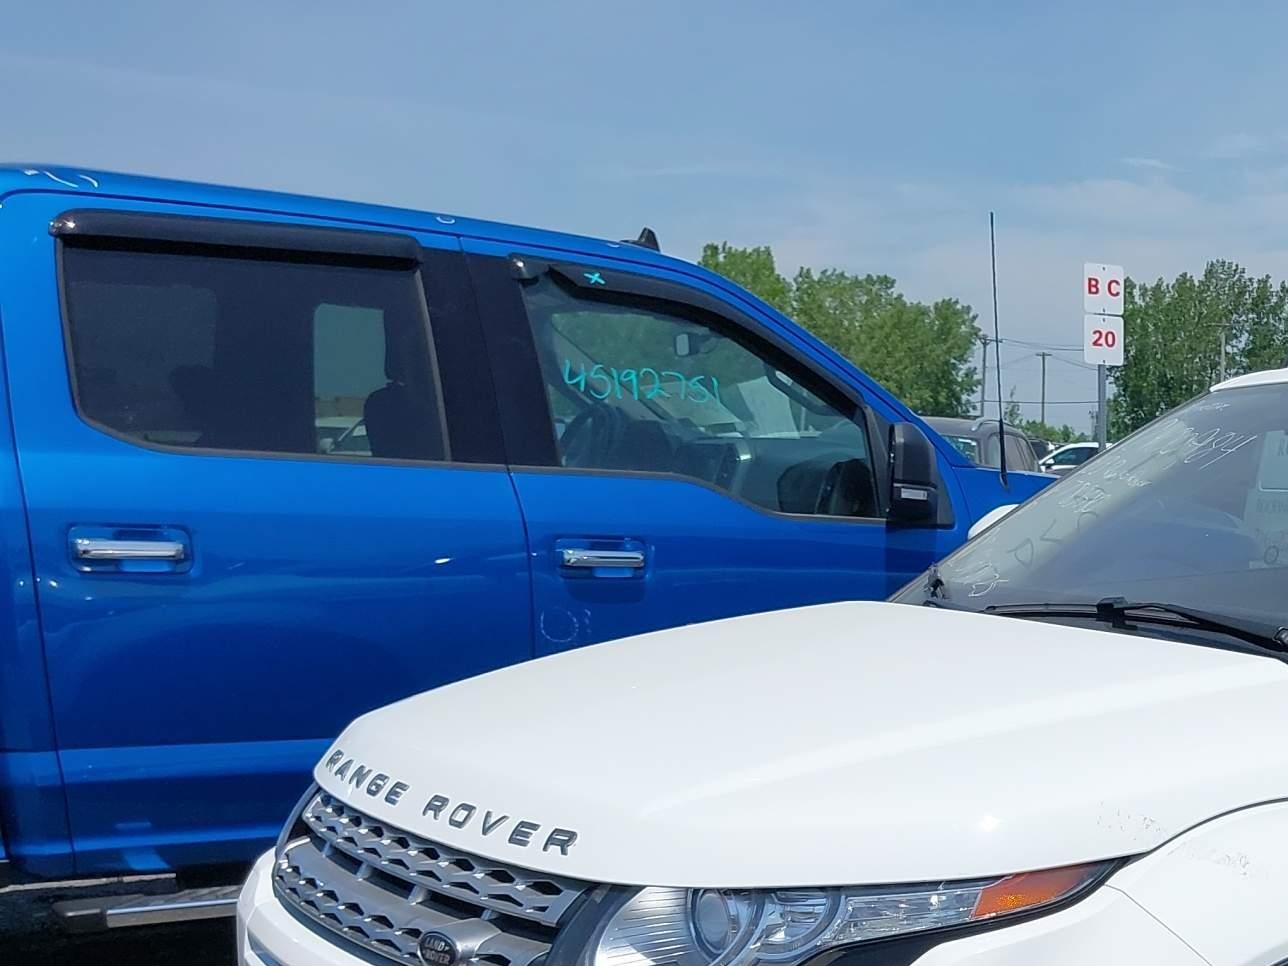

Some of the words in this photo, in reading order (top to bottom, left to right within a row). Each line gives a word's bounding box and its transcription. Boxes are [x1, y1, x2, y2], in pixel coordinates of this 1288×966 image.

[1087, 277, 1100, 295] B
[1107, 279, 1121, 297] C
[1092, 329, 1116, 348] 20
[563, 359, 722, 403] 45192751
[325, 749, 410, 806] RANGE
[422, 794, 578, 856] ROVER
